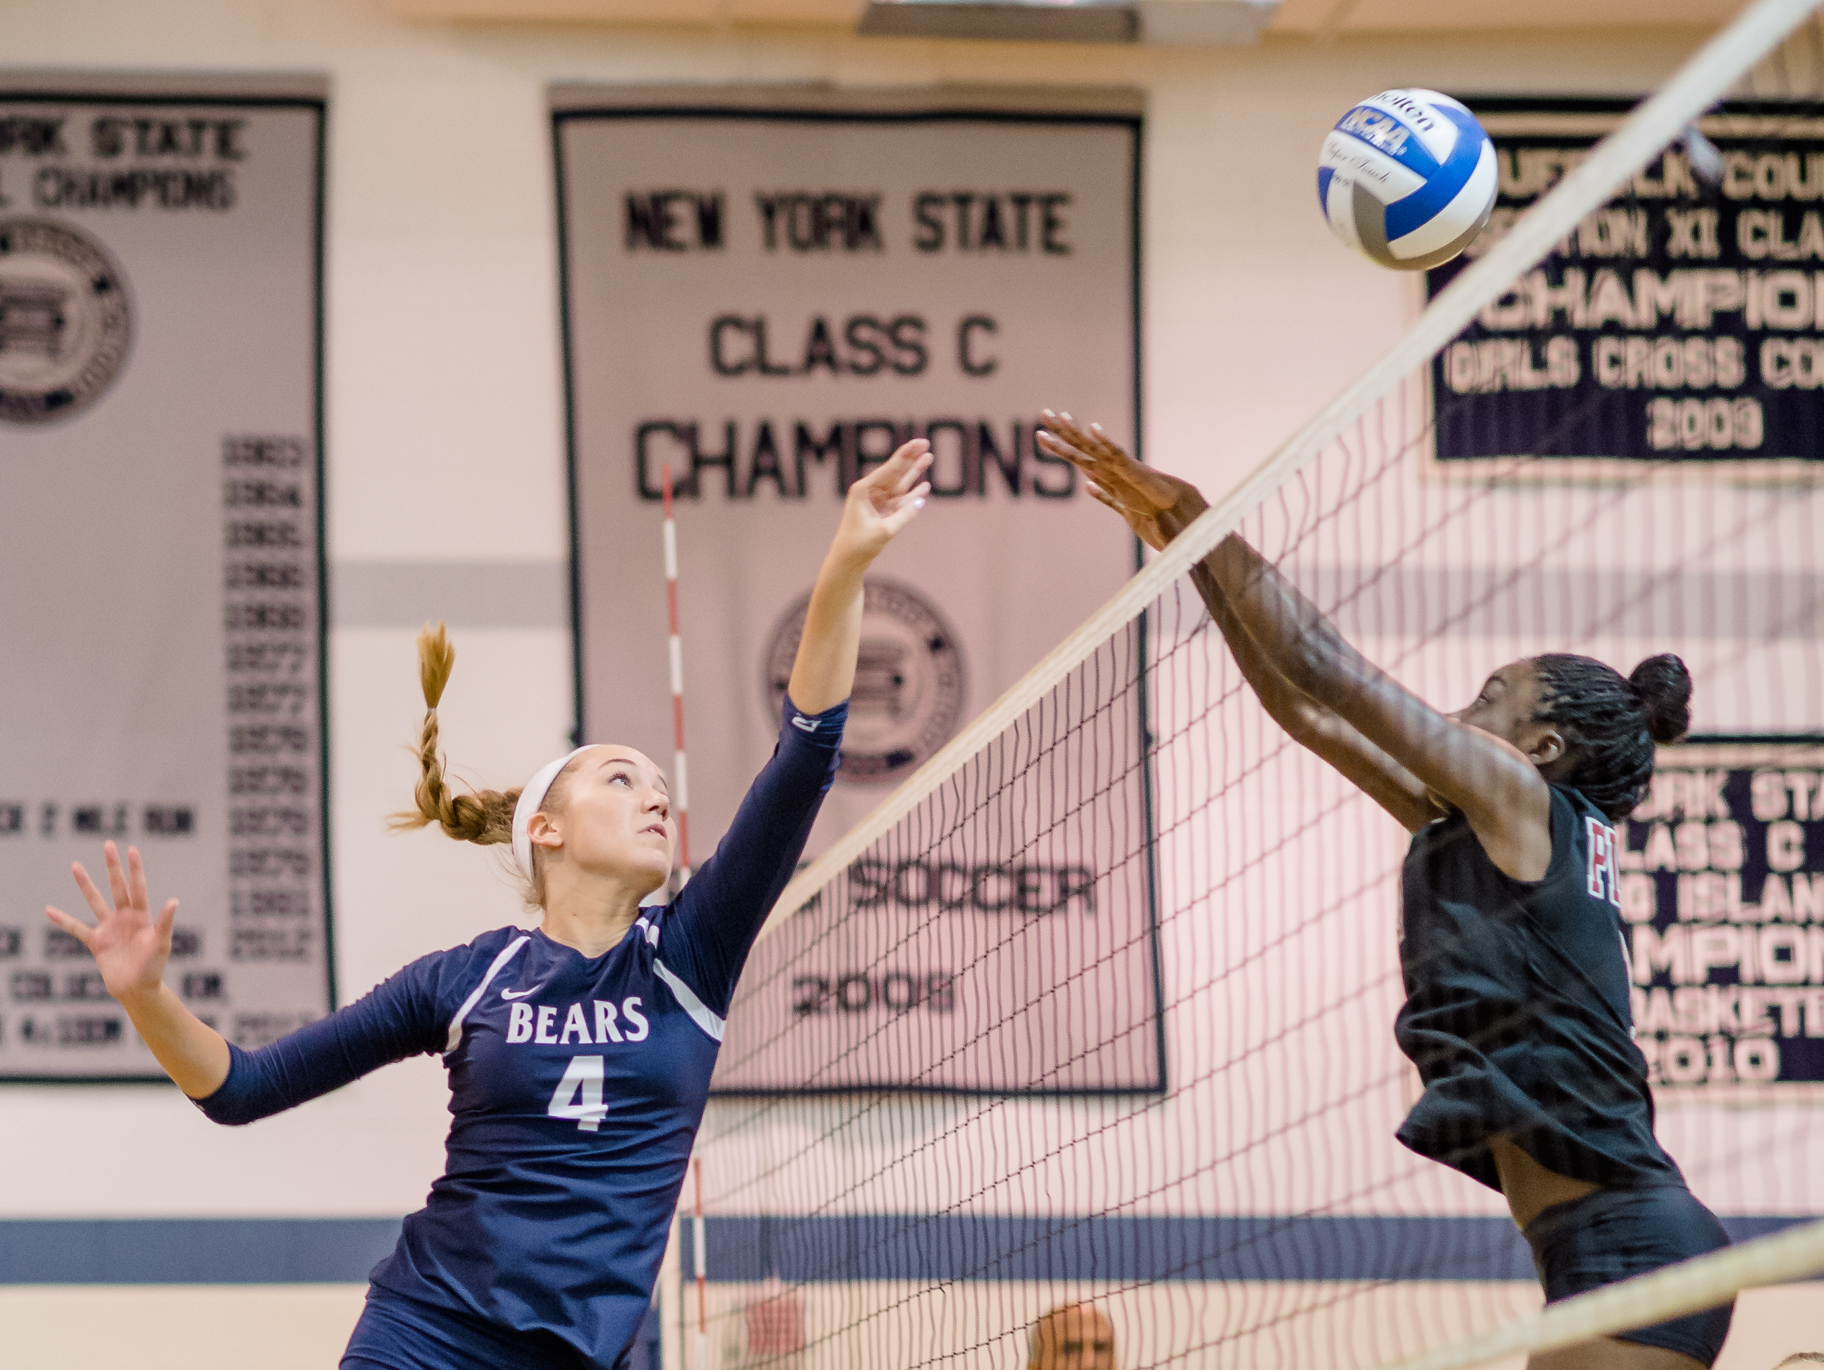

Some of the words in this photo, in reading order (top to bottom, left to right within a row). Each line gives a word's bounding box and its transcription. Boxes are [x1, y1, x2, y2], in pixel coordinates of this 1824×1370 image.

[93, 118, 245, 159] STATE
[625, 190, 726, 252] NEW
[752, 190, 884, 252] YORK
[914, 190, 1072, 255] STATE
[1665, 210, 1721, 259] XI
[1474, 268, 1824, 332] CHAMPIO
[709, 314, 928, 377] CLASS
[958, 314, 999, 377] C
[1593, 337, 1746, 389] CROSS
[1766, 820, 1806, 873] C
[849, 859, 1096, 914] SOCCER
[506, 996, 650, 1044] BEARS
[547, 1055, 609, 1132] 4
